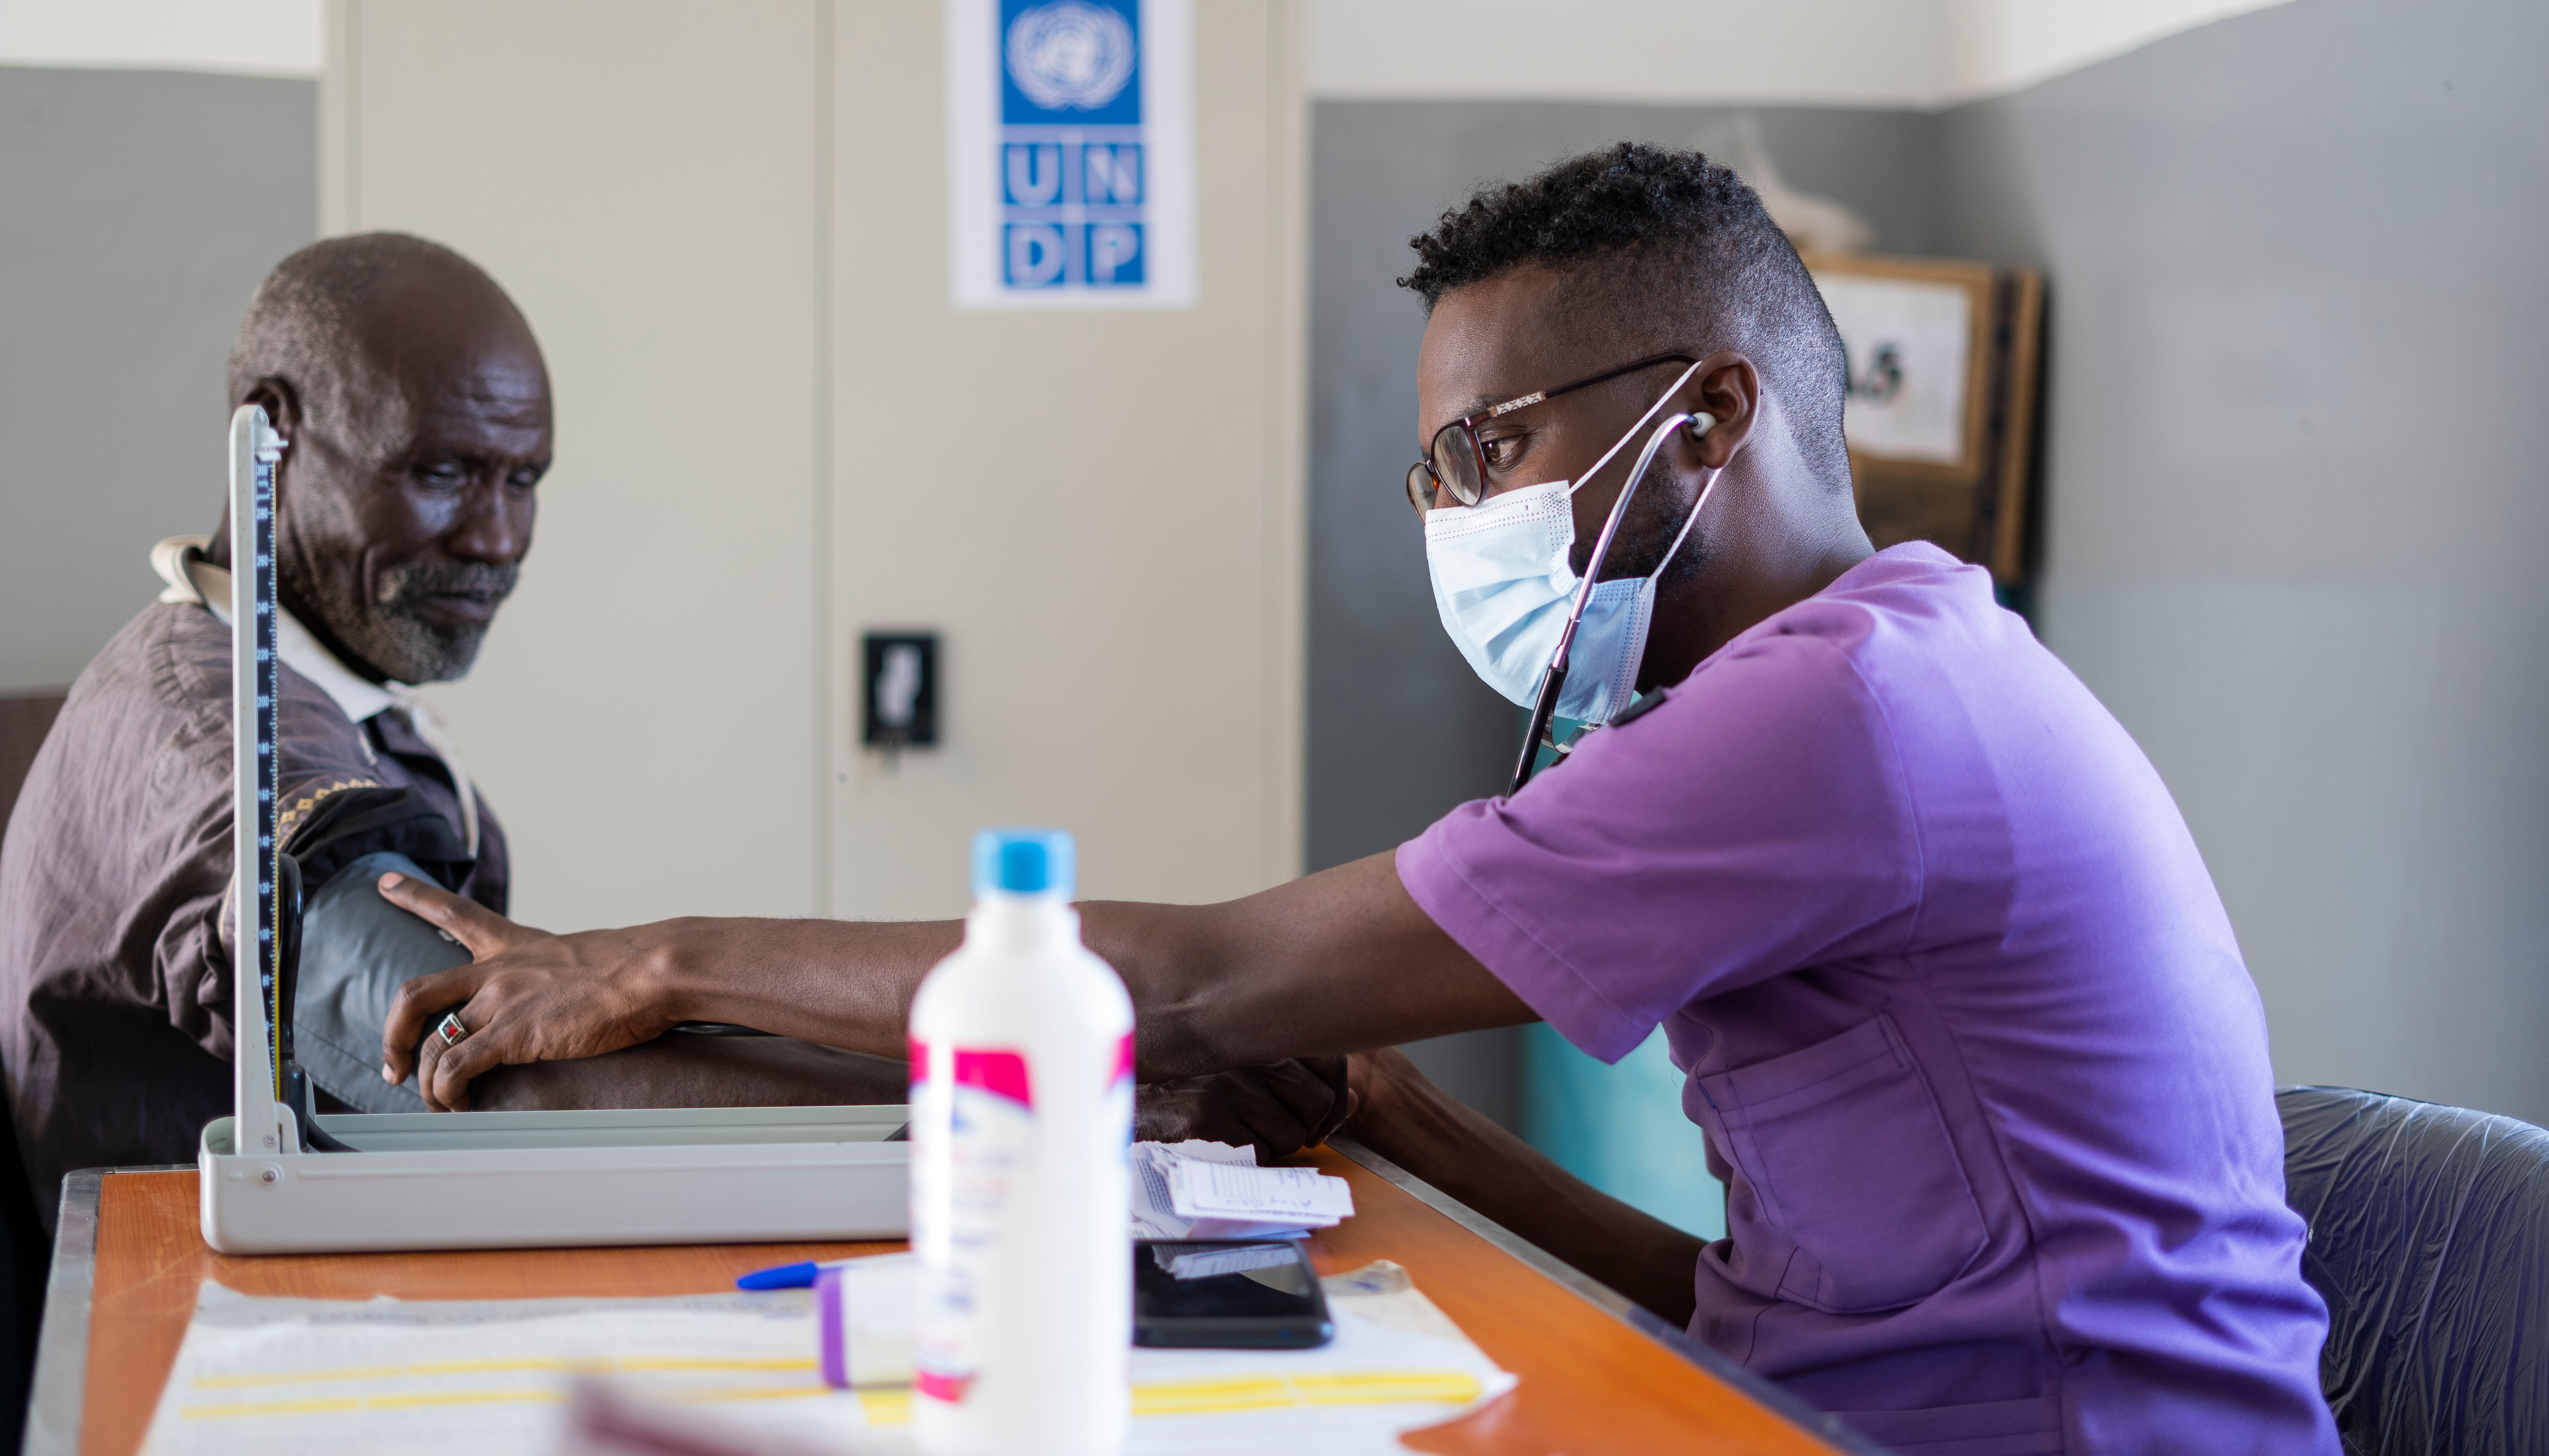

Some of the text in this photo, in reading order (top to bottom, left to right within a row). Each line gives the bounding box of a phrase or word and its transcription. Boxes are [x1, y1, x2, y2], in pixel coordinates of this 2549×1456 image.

[257, 465, 268, 476] 300
[257, 508, 268, 519] 280
[257, 554, 268, 567] 260
[257, 601, 269, 614] 240
[257, 649, 269, 660] 220
[258, 695, 269, 708] 200
[258, 742, 269, 754] 180
[259, 788, 270, 801] 160
[259, 835, 270, 848] 140
[259, 881, 270, 894] 120
[260, 928, 270, 940] 100
[262, 974, 270, 986] 80
